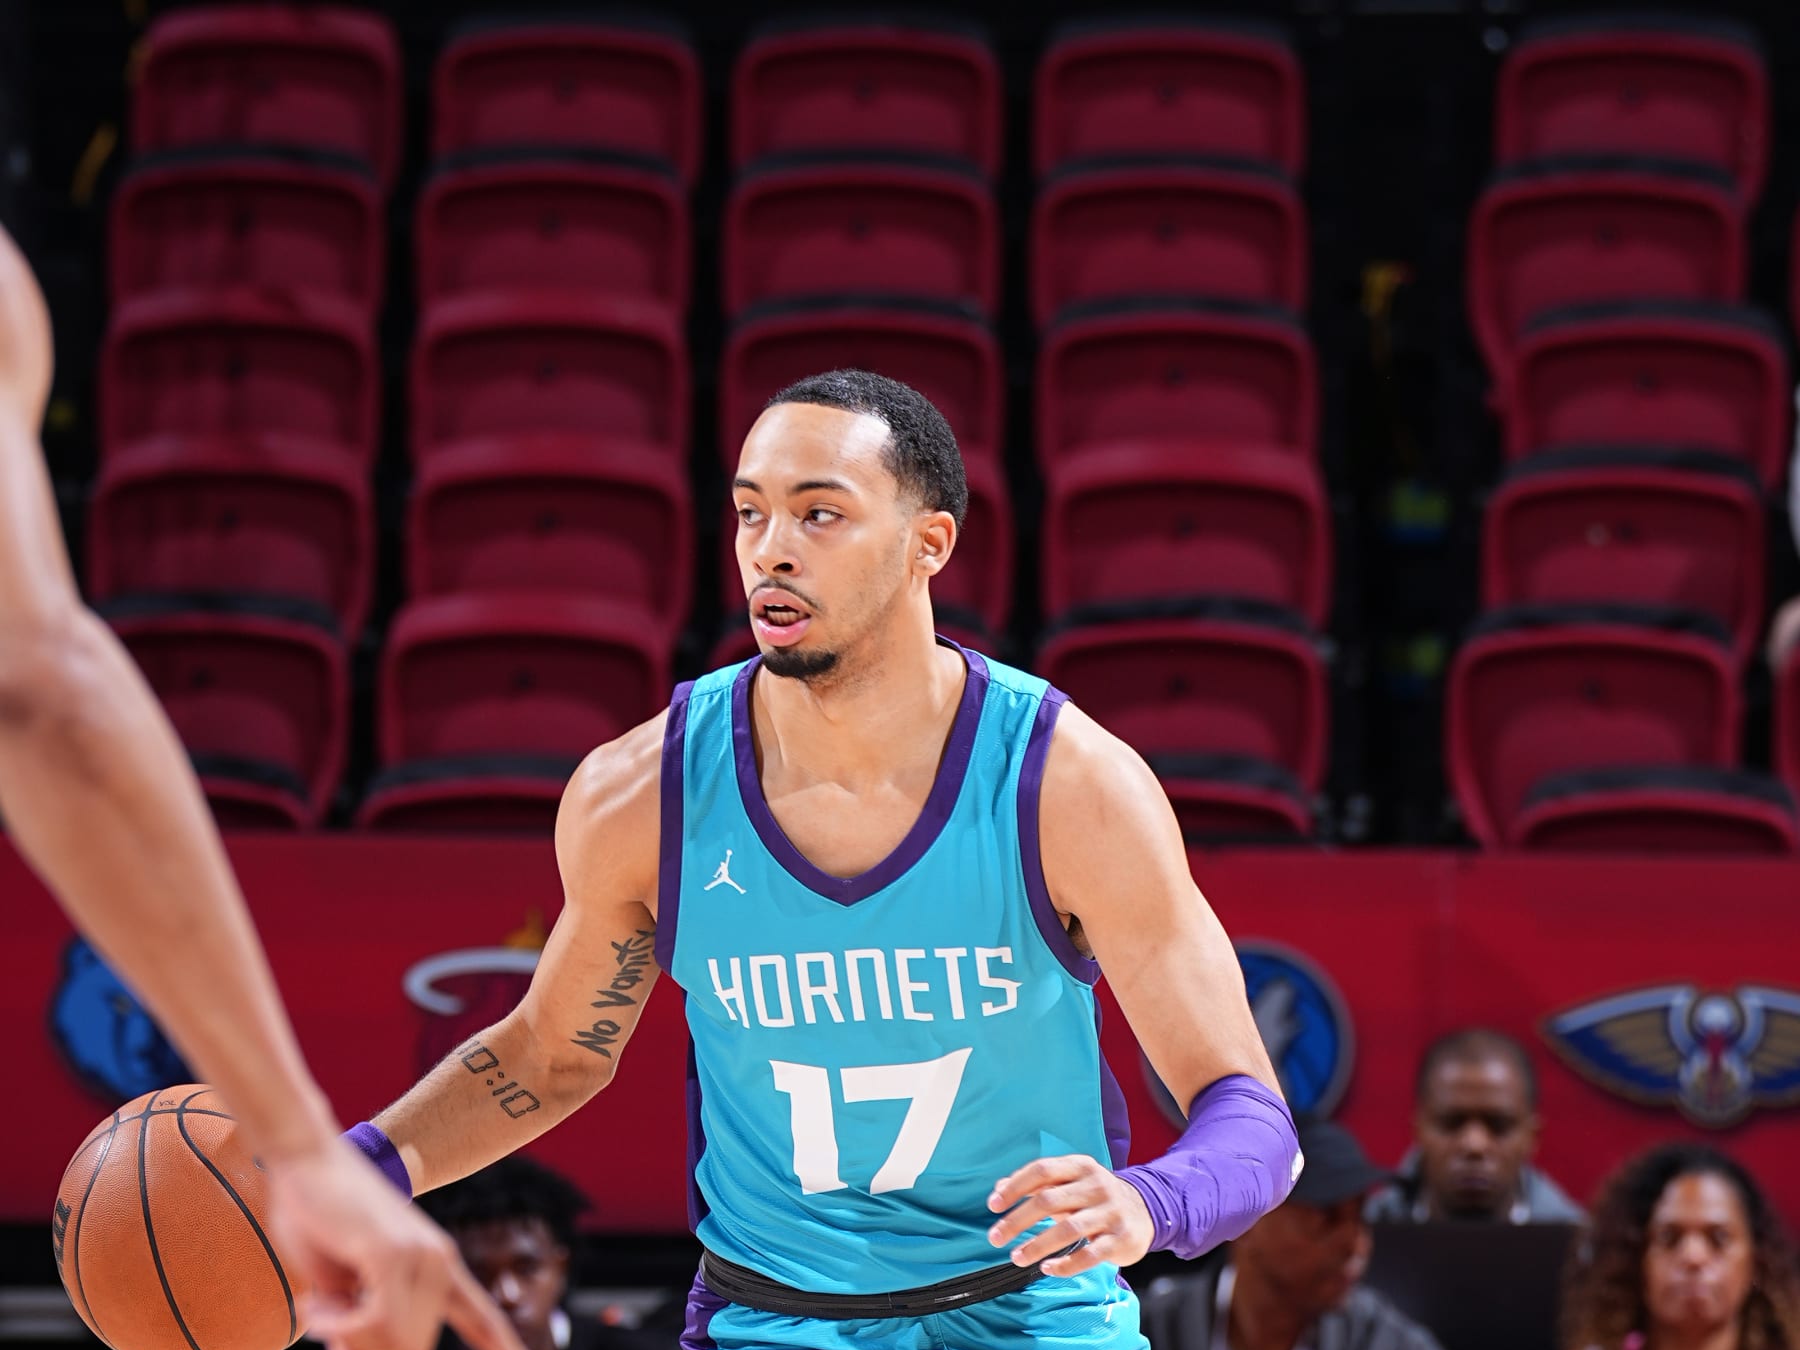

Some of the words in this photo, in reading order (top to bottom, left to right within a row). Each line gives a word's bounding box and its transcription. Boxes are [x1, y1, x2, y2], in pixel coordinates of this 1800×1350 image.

[590, 929, 656, 1009] Vanity
[707, 946, 1023, 1029] HORNETS
[570, 1019, 622, 1059] No
[768, 1047, 974, 1196] 17
